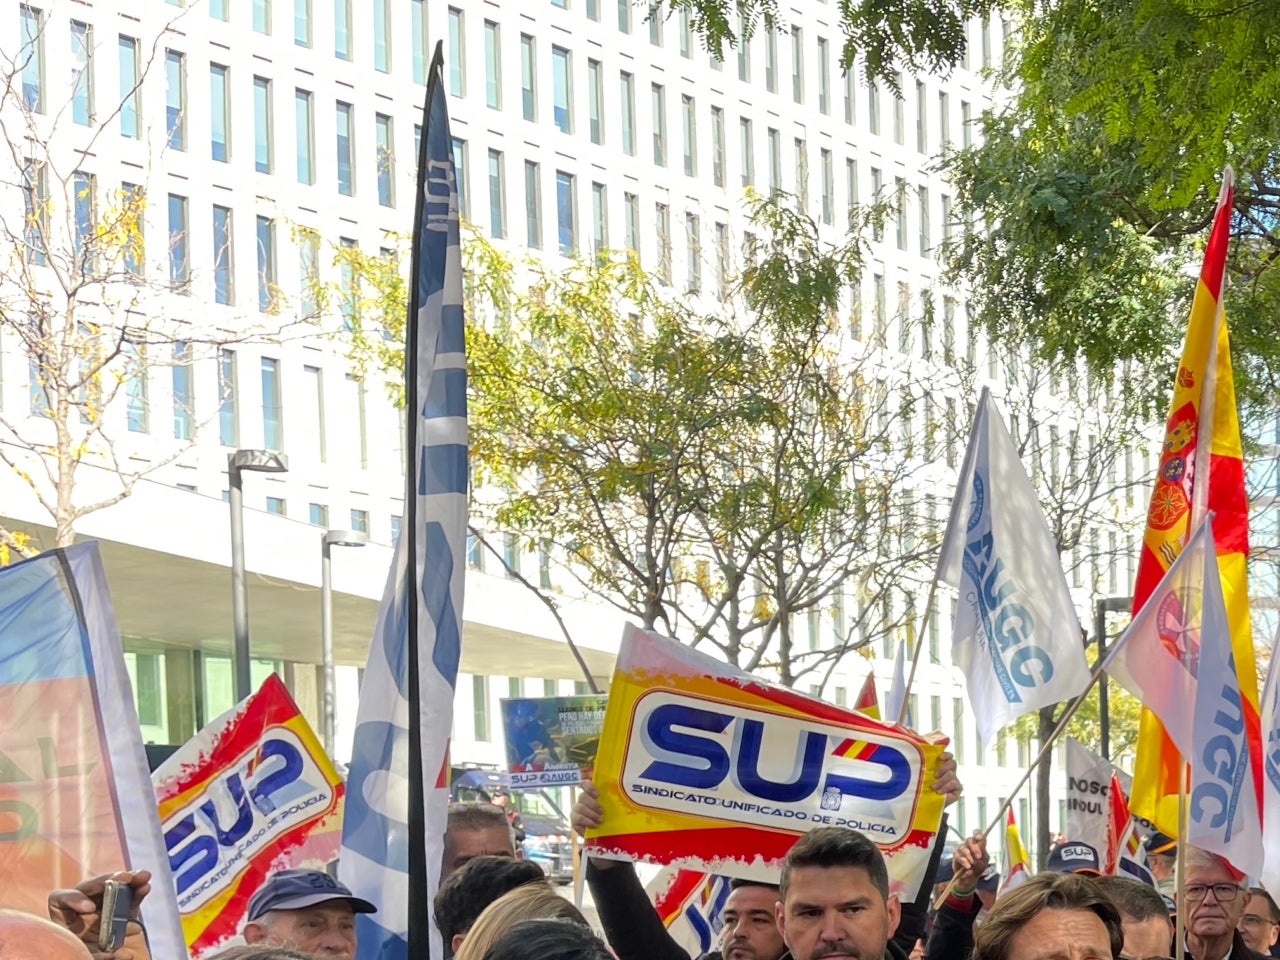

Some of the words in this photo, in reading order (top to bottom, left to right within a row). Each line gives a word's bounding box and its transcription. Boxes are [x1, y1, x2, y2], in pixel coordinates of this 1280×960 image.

[638, 703, 912, 803] SUP
[511, 774, 538, 784] SUP
[551, 772, 579, 781] AUGC
[163, 738, 304, 895] SUP
[631, 784, 717, 806] SINDICATO
[720, 797, 808, 821] UNIFICADO
[811, 813, 831, 825] DE
[1063, 846, 1093, 858] SUP
